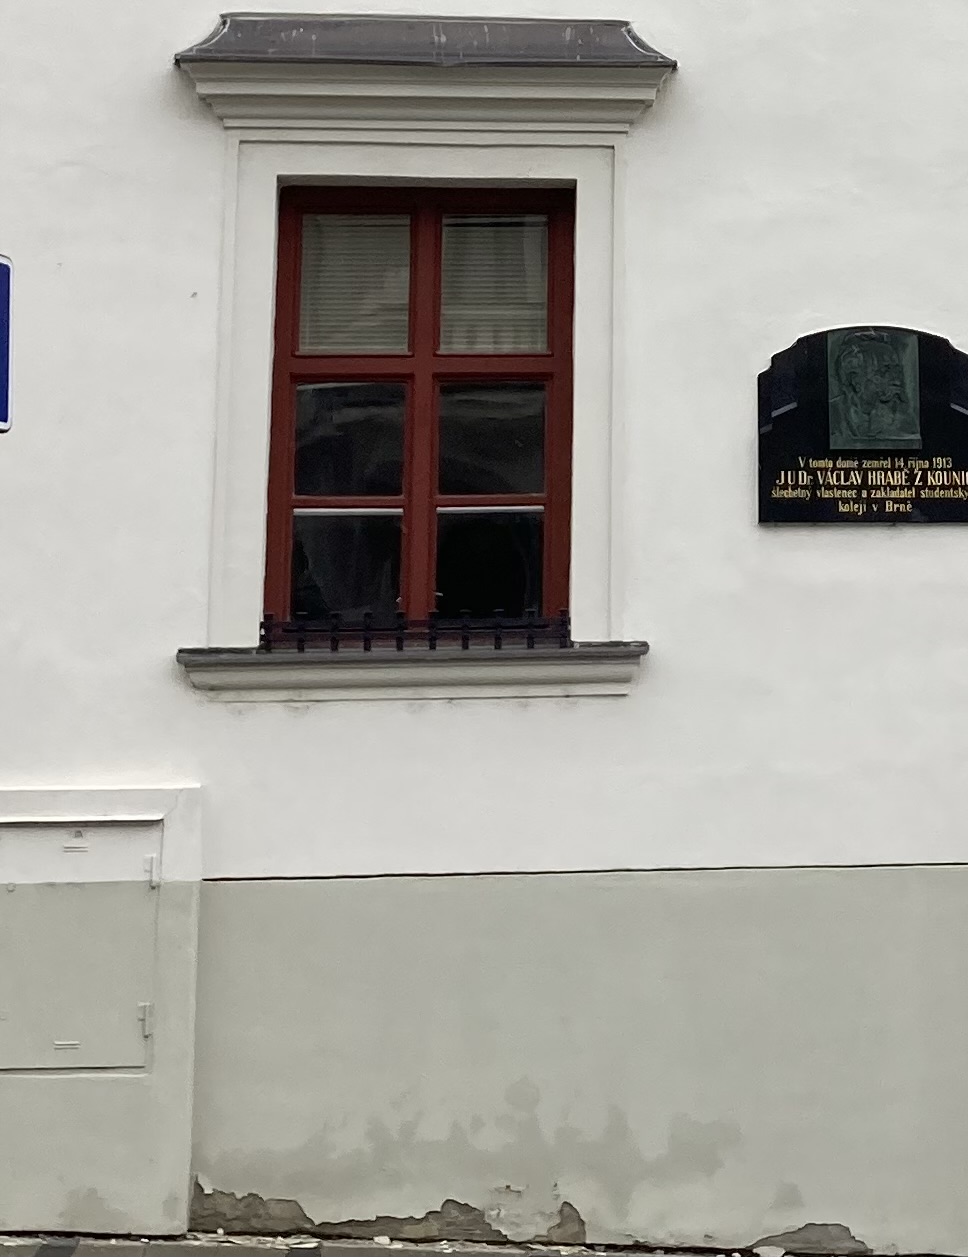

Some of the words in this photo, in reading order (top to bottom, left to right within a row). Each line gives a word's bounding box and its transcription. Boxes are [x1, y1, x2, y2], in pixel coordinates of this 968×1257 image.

[798, 456, 806, 468] V
[809, 457, 833, 468] tomto
[862, 456, 891, 468] zemřel
[932, 457, 952, 469] 1913
[816, 468, 863, 485] VÁCLAV
[867, 468, 910, 485] HRABĚ
[816, 486, 857, 498] vlastenec
[861, 489, 868, 498] a
[870, 486, 915, 498] zakladatel
[871, 503, 878, 512] v
[885, 500, 913, 512] Brně
